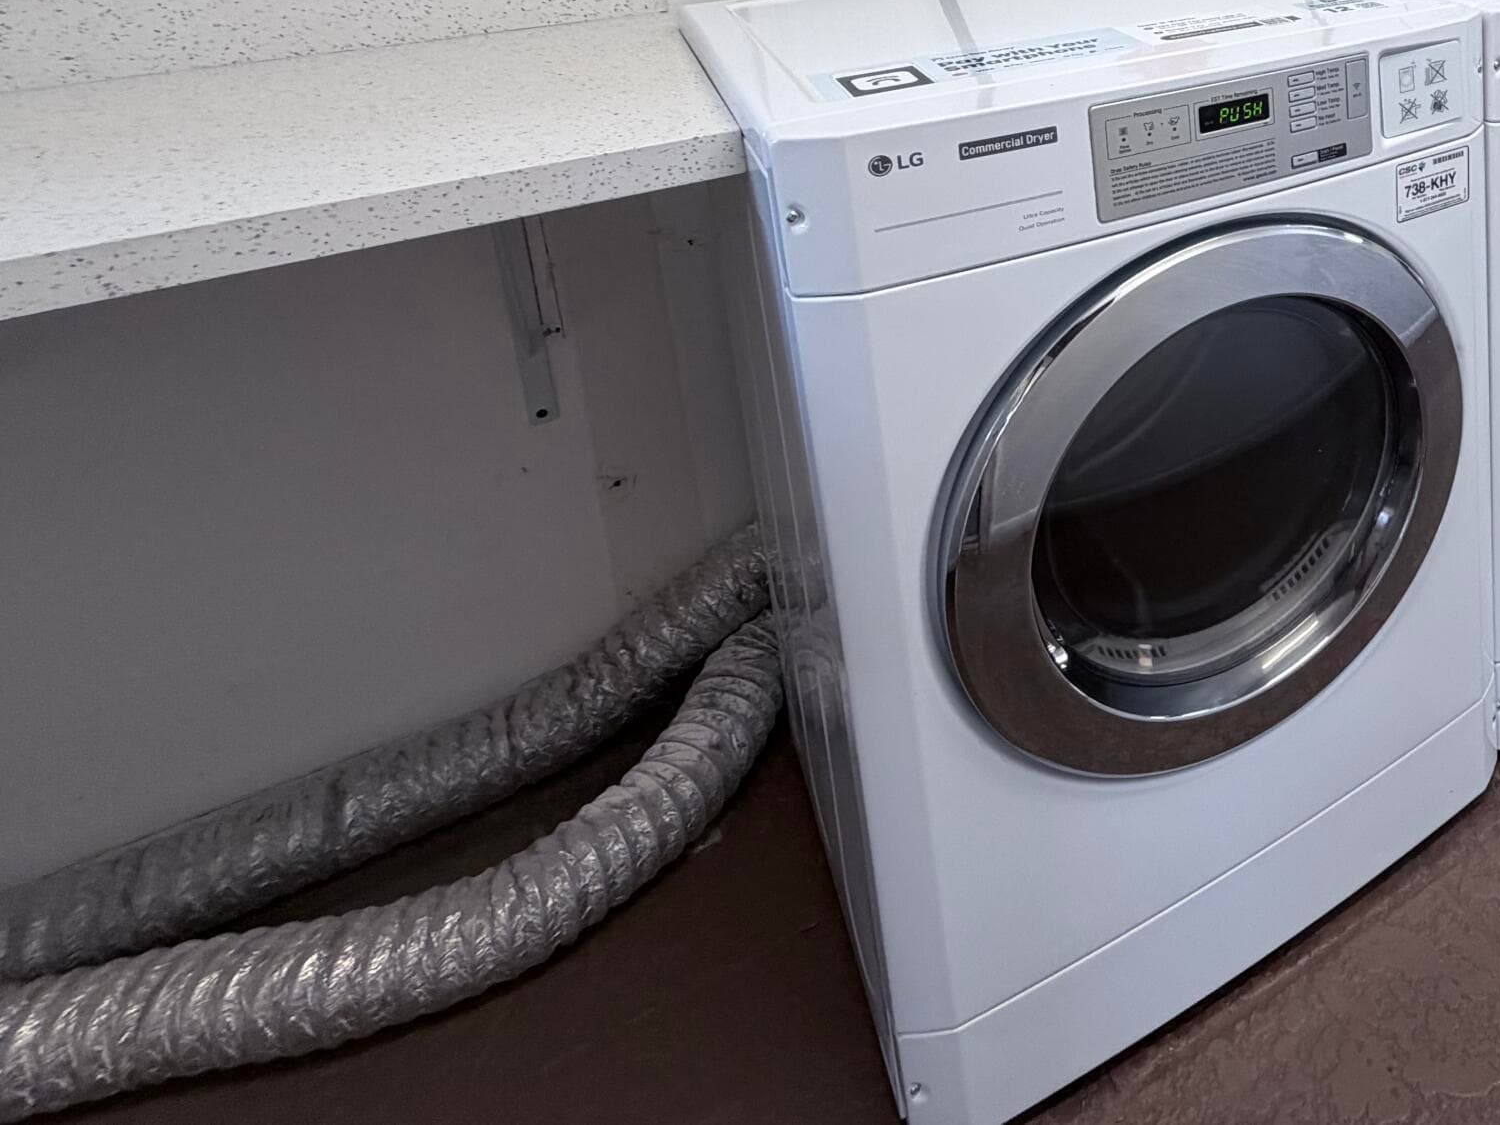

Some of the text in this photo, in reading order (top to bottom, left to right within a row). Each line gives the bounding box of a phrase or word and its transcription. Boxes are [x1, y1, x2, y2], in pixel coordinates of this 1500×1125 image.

[992, 48, 1043, 58] with
[1133, 109, 1162, 118] Processing
[1220, 102, 1263, 124] PUSH
[962, 131, 1055, 157] Commercial Dryer
[897, 152, 924, 169] LG
[1399, 165, 1418, 175] CSC
[1405, 171, 1457, 198] 738-KHY
